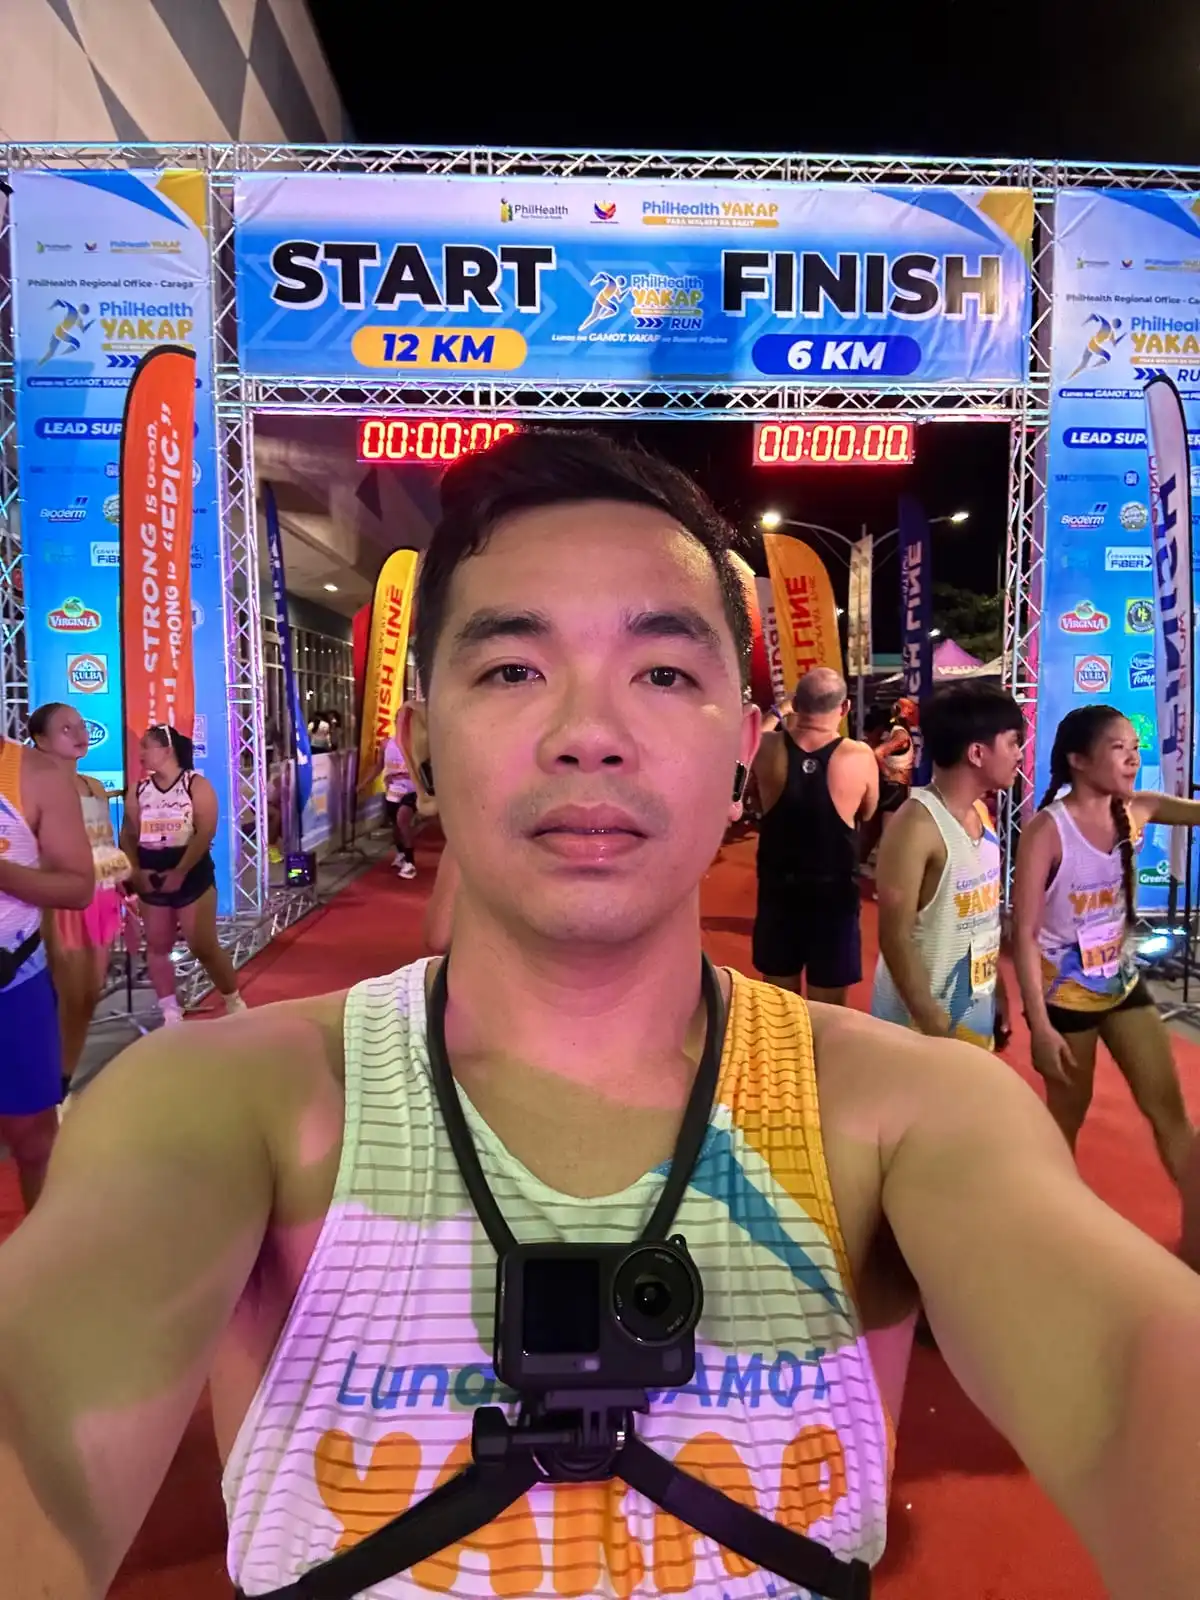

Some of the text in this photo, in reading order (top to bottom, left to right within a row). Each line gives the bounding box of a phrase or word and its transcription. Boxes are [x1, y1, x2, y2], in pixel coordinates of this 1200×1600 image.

[514, 204, 569, 215] PhilHealth
[642, 200, 779, 217] PhilHealth YAKAP
[28, 278, 77, 288] PhilHealth
[79, 279, 121, 289] Regional
[123, 279, 153, 288] Office
[160, 279, 194, 290] Caraga
[270, 240, 557, 314] START
[631, 274, 704, 289] PhilHealth
[720, 249, 1002, 321] FINISH
[631, 288, 704, 307] YAKAP
[1114, 294, 1152, 304] Regional
[99, 301, 194, 318] PhilHealth
[100, 318, 194, 341] YAKAP
[671, 317, 703, 330] RUN
[382, 333, 496, 363] 12 KM
[786, 340, 886, 371] 6 KM
[43, 422, 88, 435] LEAD
[1070, 432, 1112, 444] LEAD
[146, 494, 158, 515] IS
[140, 522, 162, 673] STRONG
[50, 615, 98, 627] VIRGINIA
[383, 583, 404, 658] LINE
[1061, 617, 1106, 630] VIRGINIA
[71, 670, 104, 683] KULBA
[1077, 670, 1107, 682] KULBA
[338, 1351, 516, 1410] Luna
